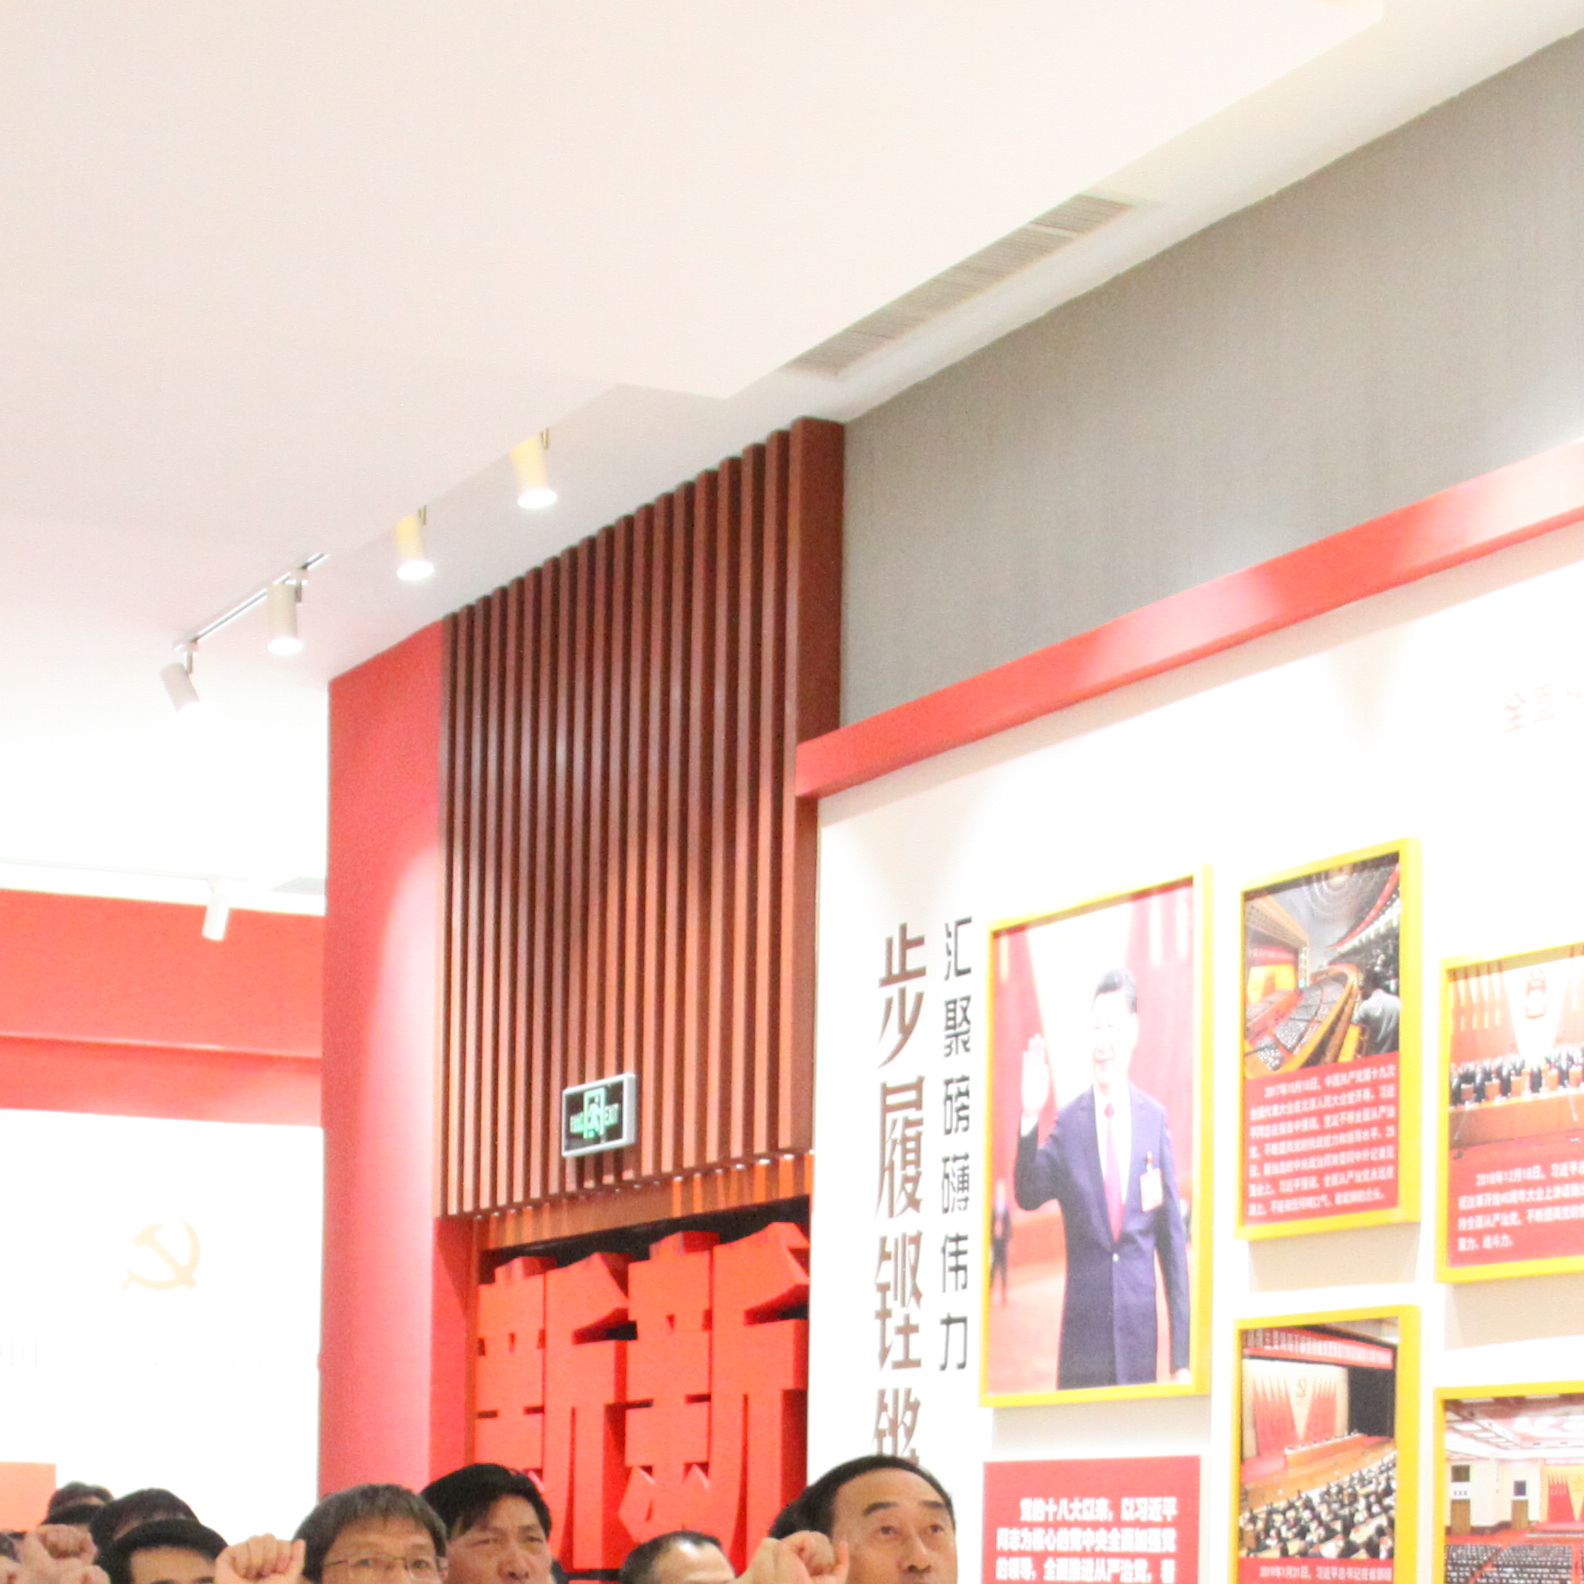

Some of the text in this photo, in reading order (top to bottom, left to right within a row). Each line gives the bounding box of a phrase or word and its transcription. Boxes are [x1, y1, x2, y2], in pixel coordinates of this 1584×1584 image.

[940, 916, 973, 1372] 汇聚磅礴伟力
[996, 1527, 1177, 1553] 同志为核心的党中央全面加强党
